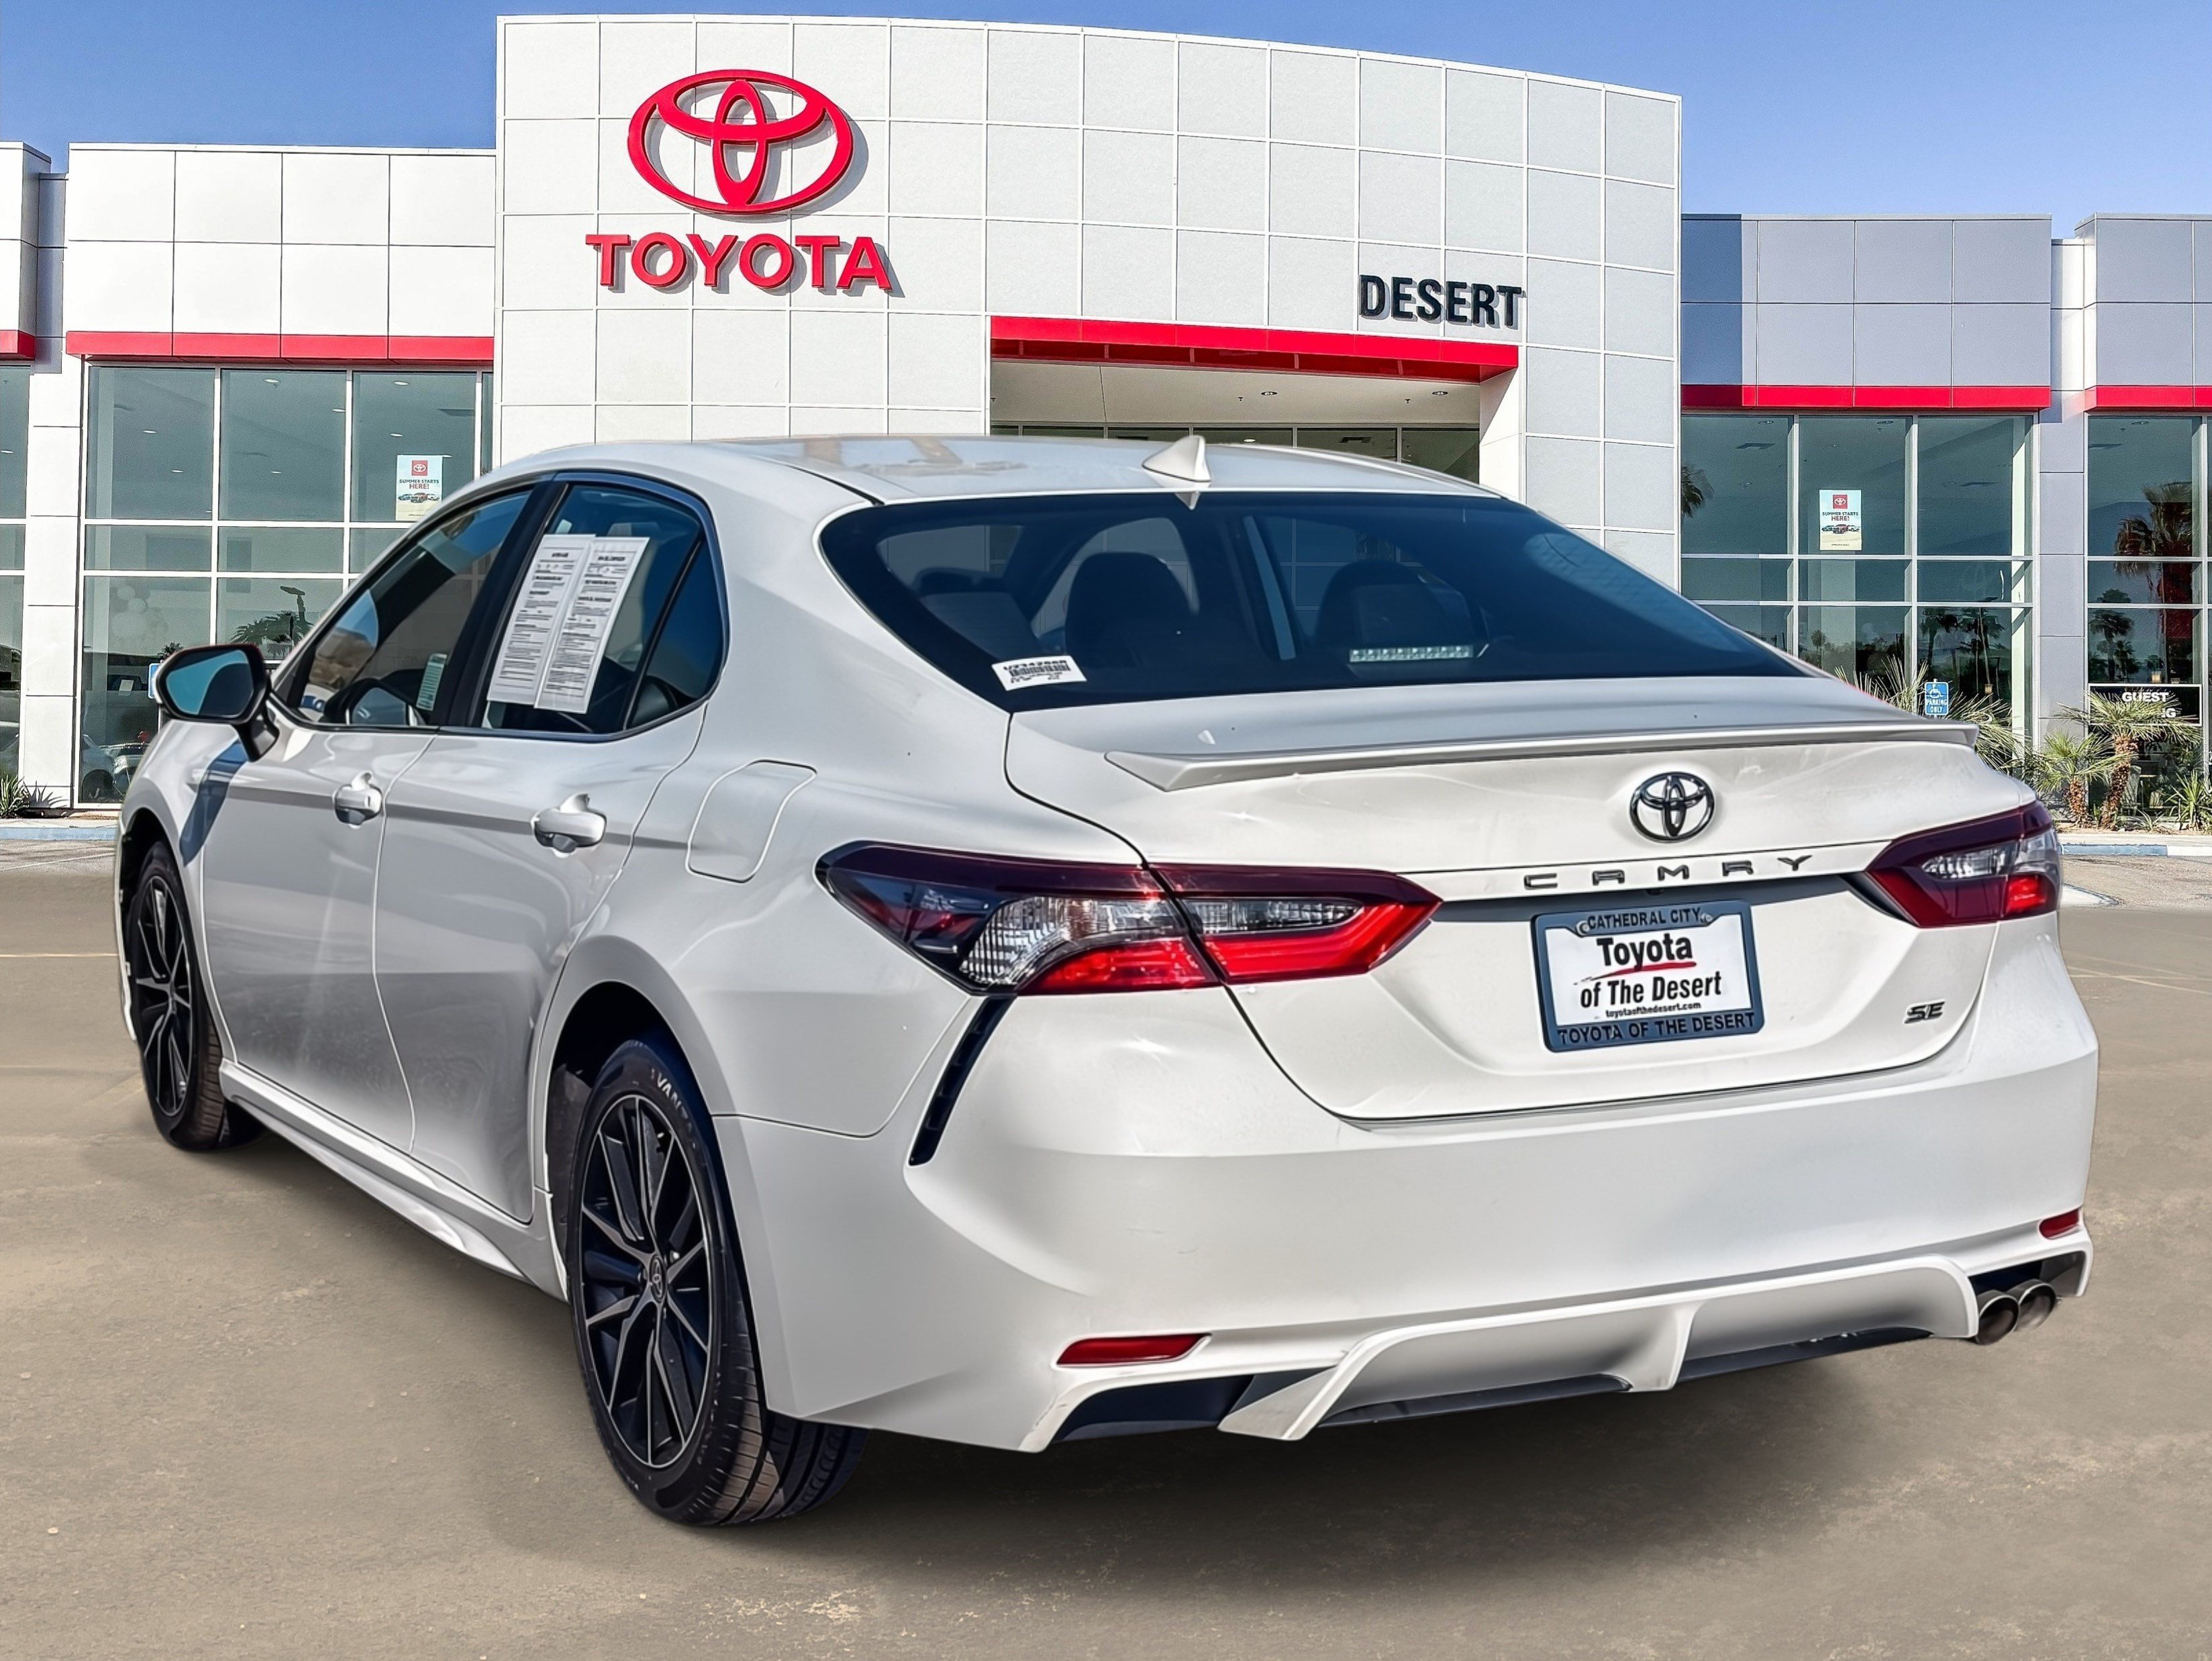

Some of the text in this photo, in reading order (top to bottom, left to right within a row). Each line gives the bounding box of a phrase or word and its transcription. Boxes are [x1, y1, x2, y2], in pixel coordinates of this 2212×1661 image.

[585, 232, 893, 291] TOYOTA
[1359, 274, 1522, 327] DESERT
[2121, 691, 2169, 703] GUEST
[1523, 855, 1813, 890] CAMRY
[1587, 907, 1701, 930] CATHEDRAL CITY
[1597, 933, 1693, 971] Toyota
[1580, 971, 1722, 1008] of The Desert
[1605, 1003, 1701, 1019] toyotaofthedesert.com
[1904, 1001, 1946, 1024] SE
[1557, 1012, 1755, 1045] TOYOTA OF THE DESERT
